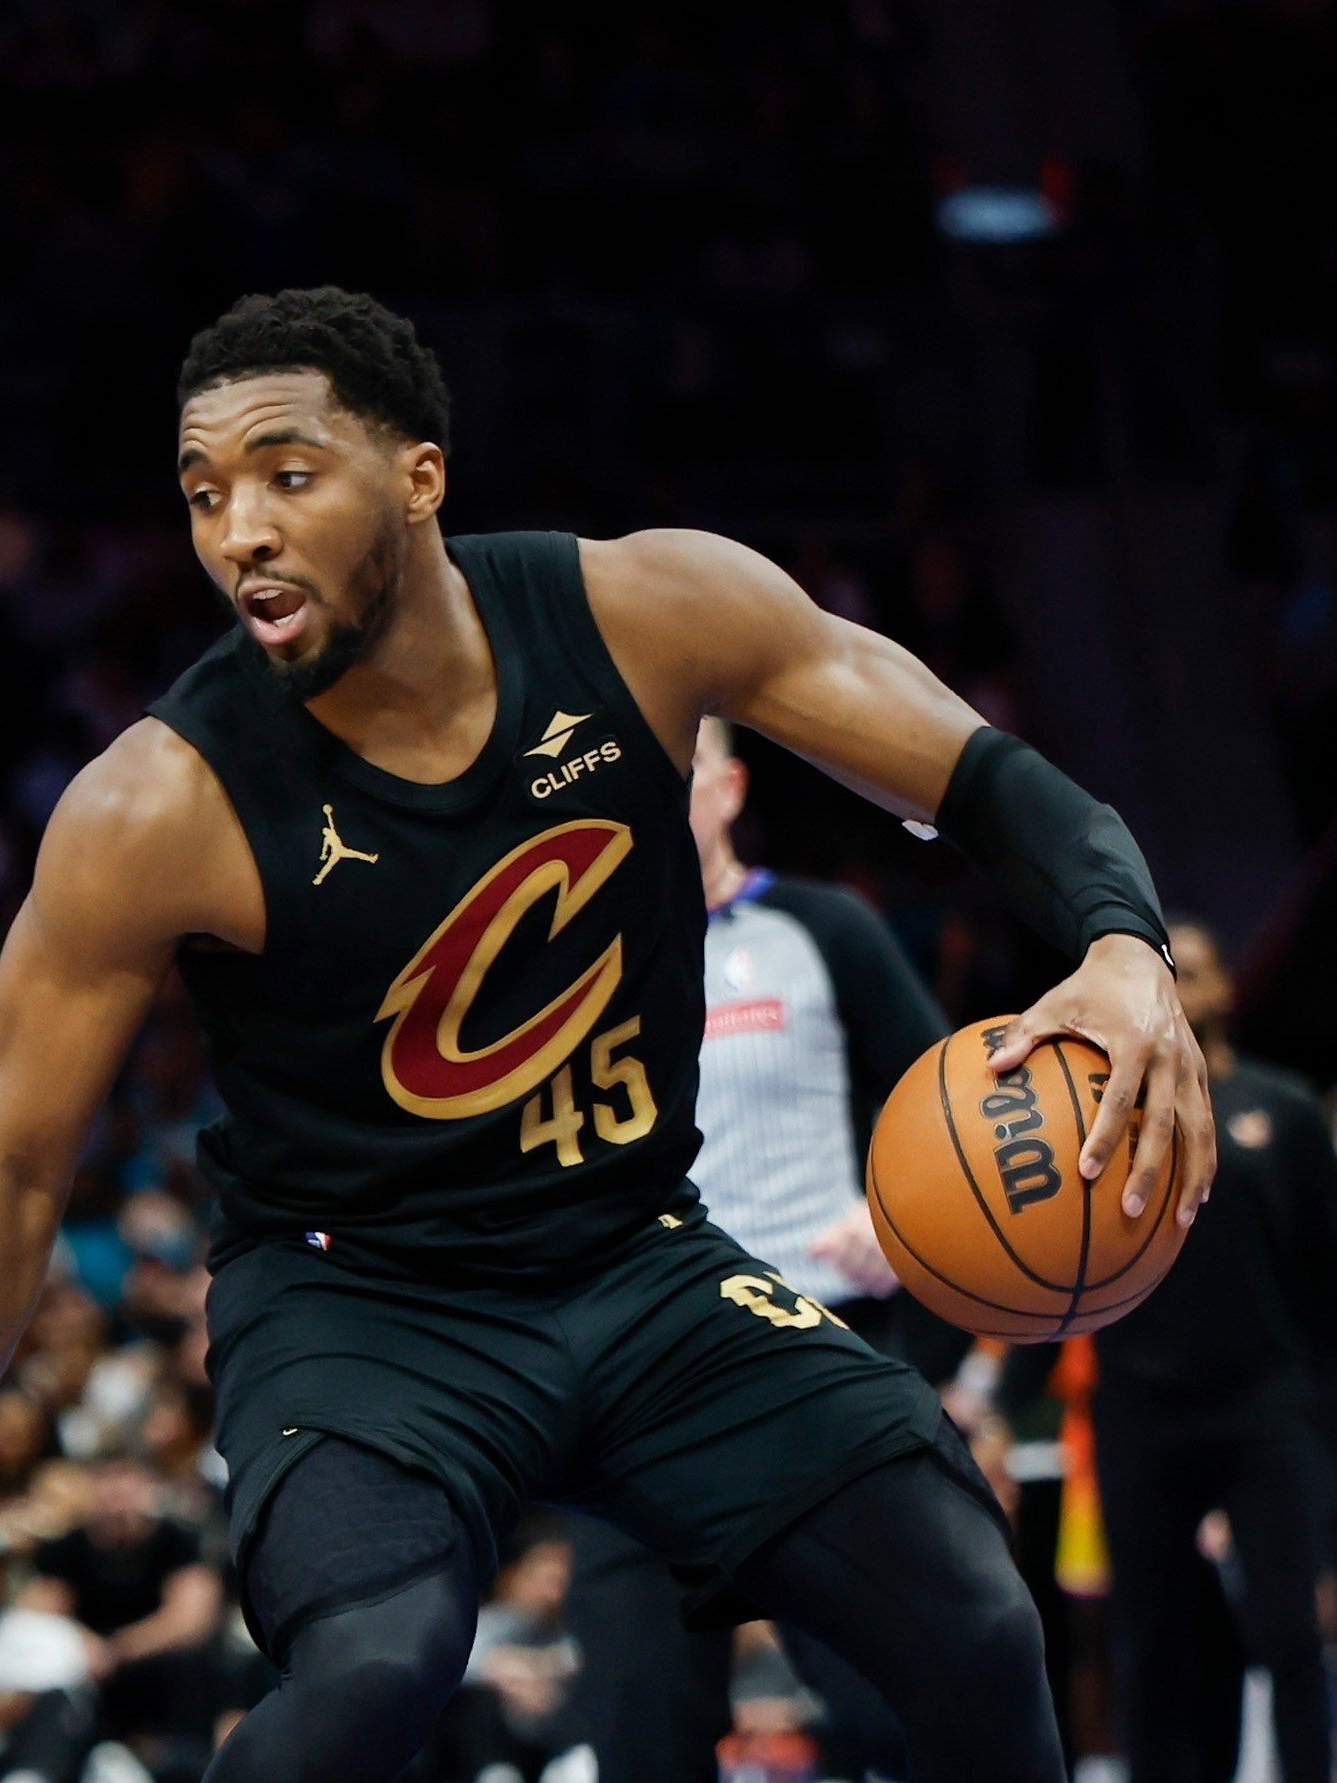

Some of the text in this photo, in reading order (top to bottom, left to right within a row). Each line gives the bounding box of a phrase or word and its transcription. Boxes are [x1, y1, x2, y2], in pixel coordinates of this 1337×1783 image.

[530, 741, 622, 799] CLIFFS
[373, 818, 634, 1120] C
[519, 1014, 659, 1168] 45
